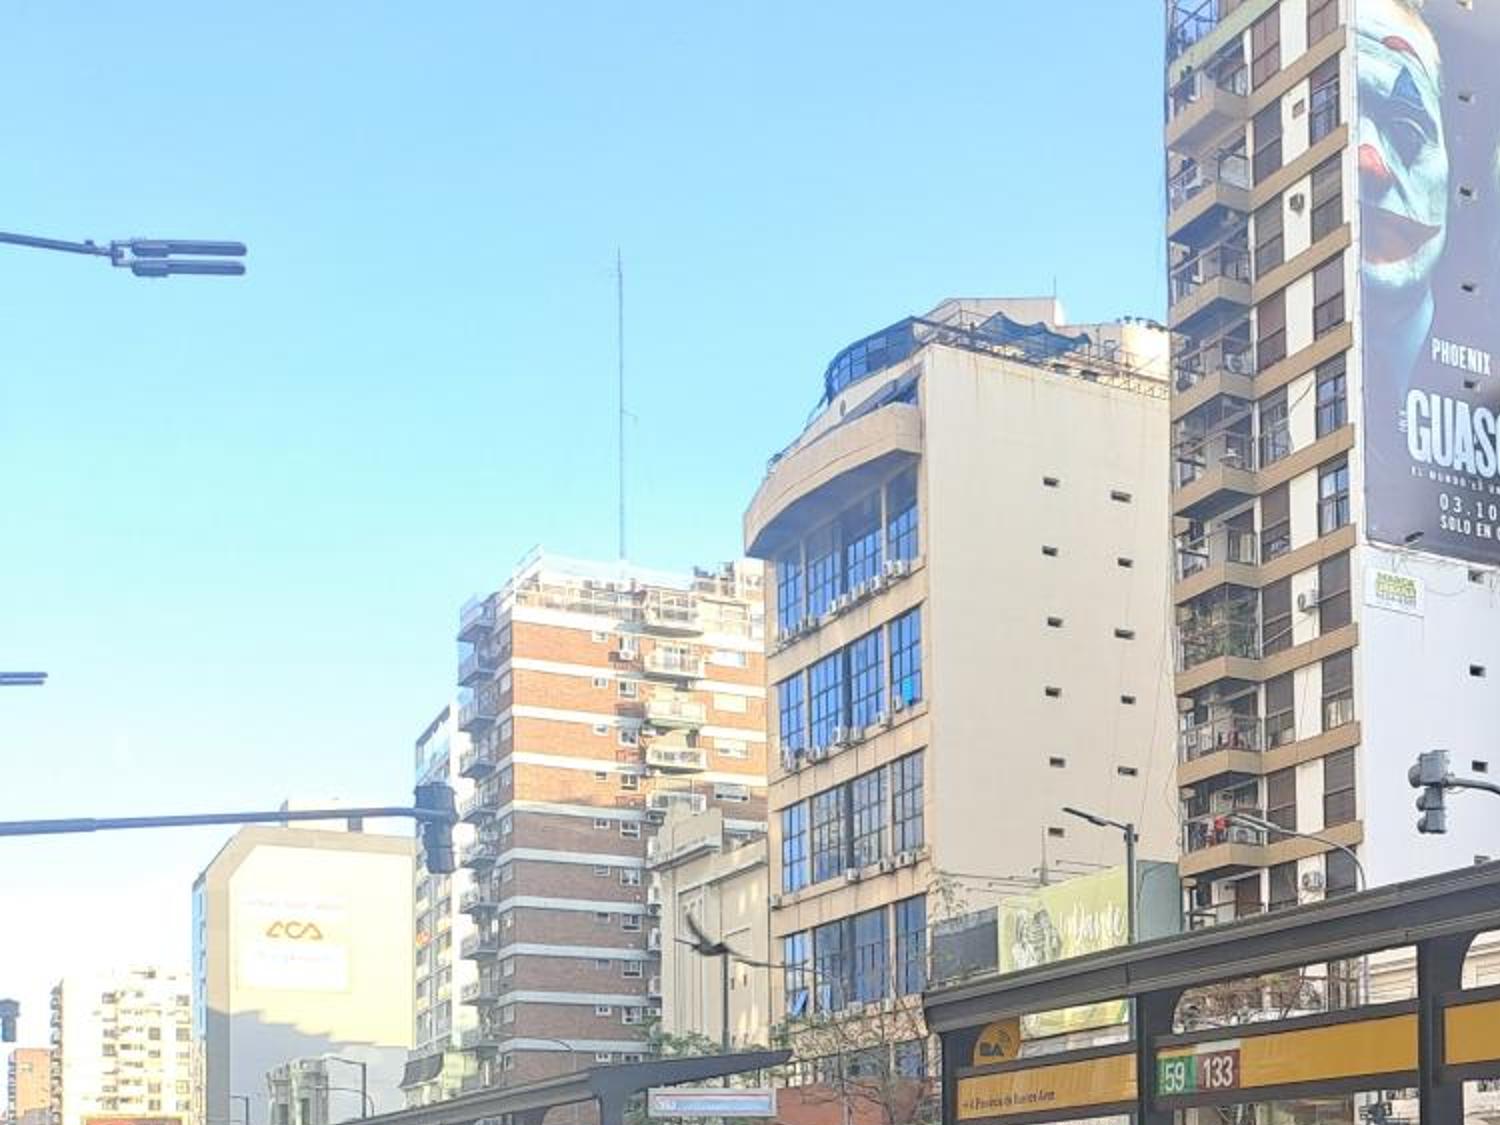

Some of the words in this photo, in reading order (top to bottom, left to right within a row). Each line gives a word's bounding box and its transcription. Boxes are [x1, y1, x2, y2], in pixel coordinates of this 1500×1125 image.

[1431, 337, 1491, 376] PHOENIX
[1440, 515, 1472, 535] SOLO
[1476, 522, 1492, 539] EN
[1165, 1061, 1185, 1092] 59
[1203, 1055, 1233, 1089] 133
